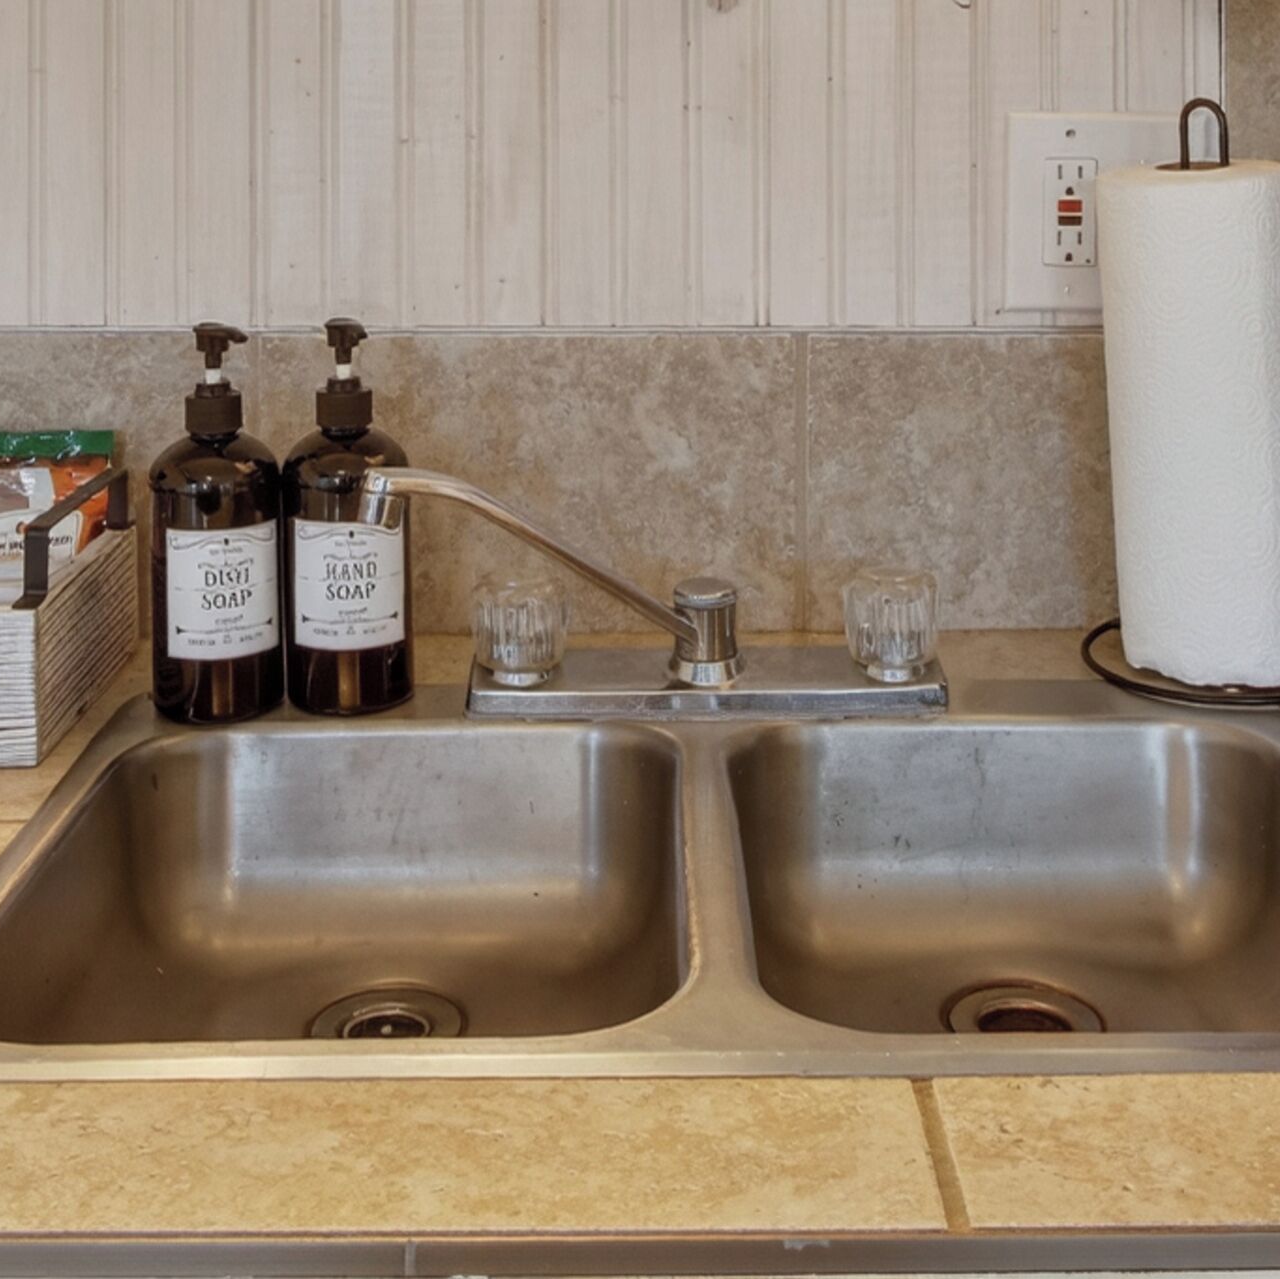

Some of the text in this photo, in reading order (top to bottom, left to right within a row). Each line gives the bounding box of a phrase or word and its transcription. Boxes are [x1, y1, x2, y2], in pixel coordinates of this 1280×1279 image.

[205, 568, 249, 587] DISH
[326, 561, 377, 580] HAND
[201, 589, 253, 610] SOAP
[325, 582, 376, 601] SOAP
